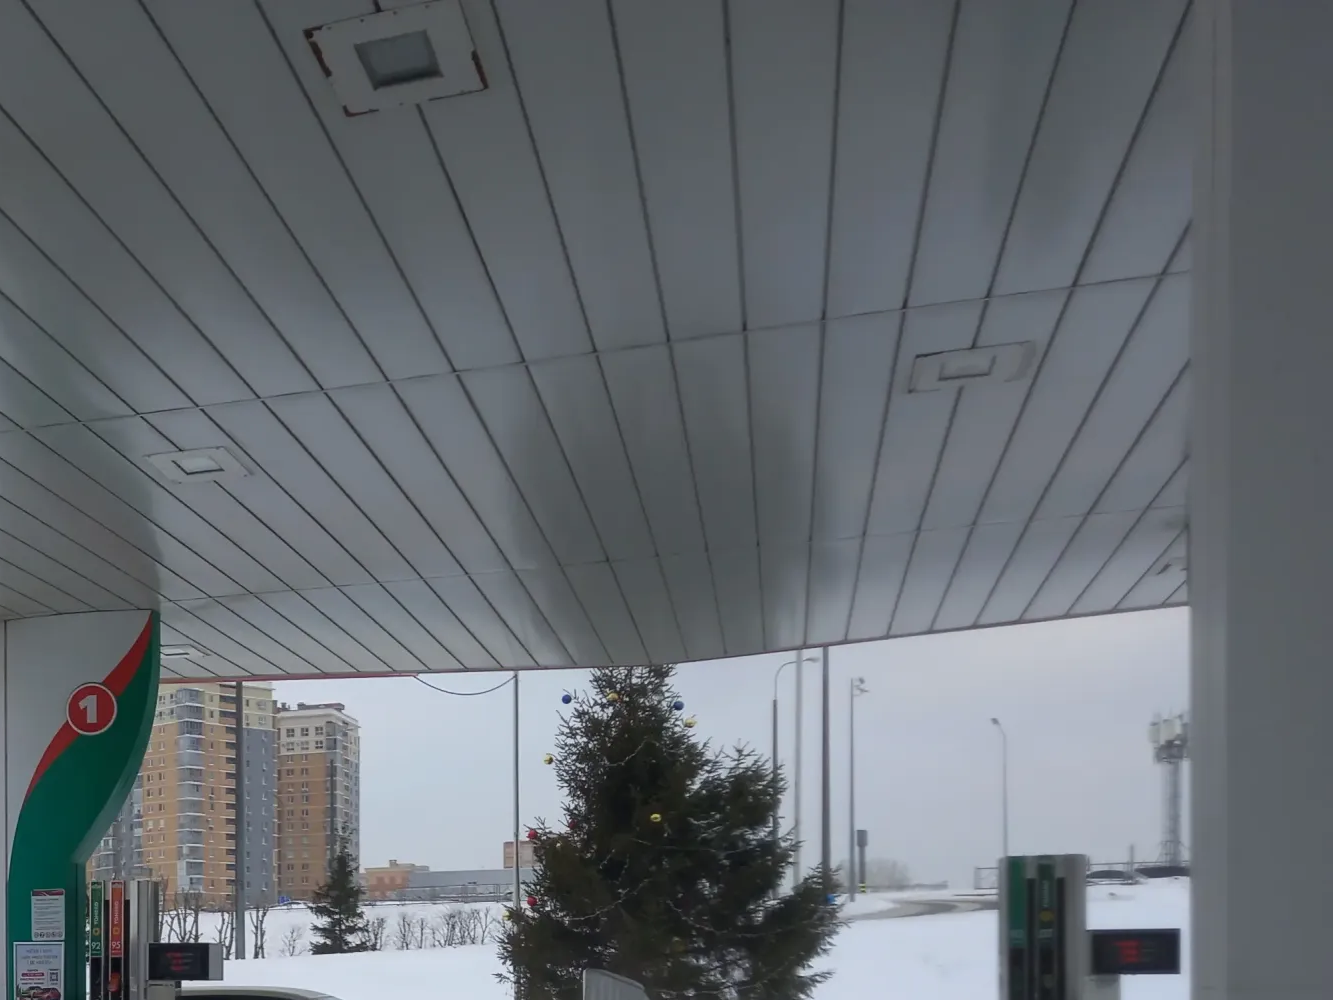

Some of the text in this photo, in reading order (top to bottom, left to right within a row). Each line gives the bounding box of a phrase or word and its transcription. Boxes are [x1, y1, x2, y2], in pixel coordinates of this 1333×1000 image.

[78, 694, 98, 724] 1
[91, 941, 101, 950] 92
[111, 941, 121, 950] 95
